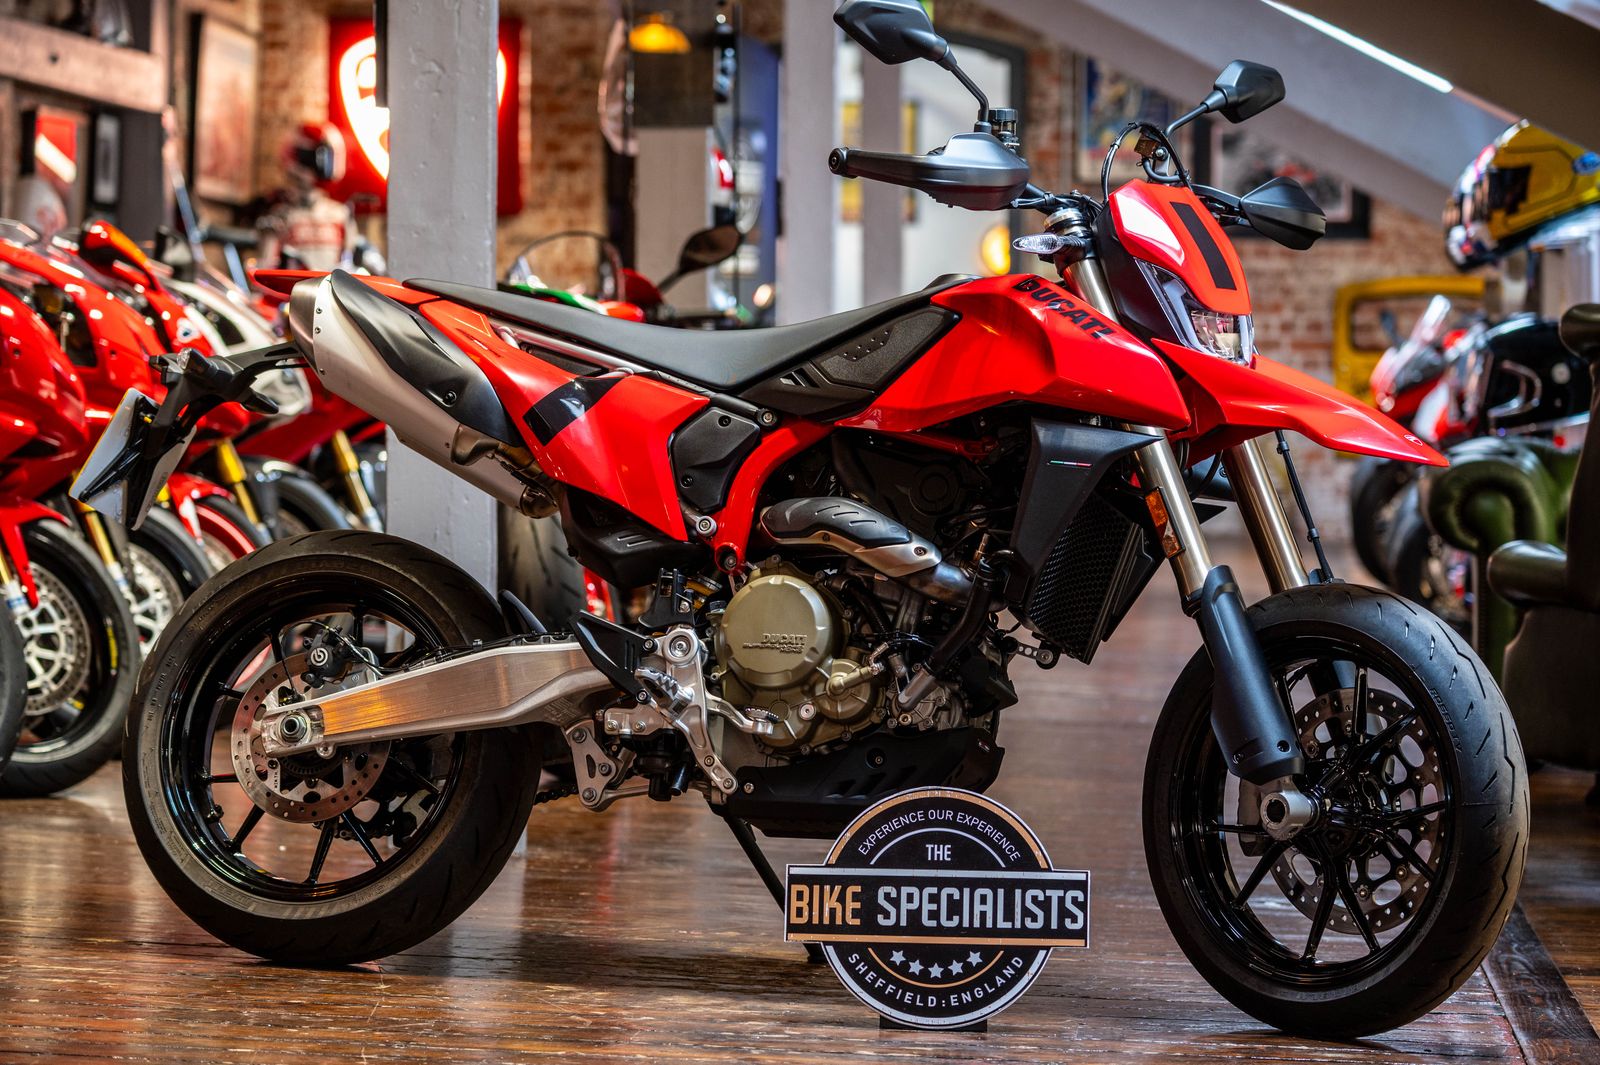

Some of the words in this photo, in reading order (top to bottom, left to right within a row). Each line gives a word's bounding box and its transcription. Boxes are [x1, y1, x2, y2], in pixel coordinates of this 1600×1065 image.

[1012, 279, 1114, 338] DUCATI
[761, 633, 807, 645] DUCATI
[858, 809, 926, 856] EXPERIENCE
[927, 809, 954, 822] OUR
[956, 811, 1022, 862] EXPERIENCE
[925, 843, 952, 862] THE
[789, 884, 862, 926] BIKE
[876, 885, 1085, 930] SPECIALISTS
